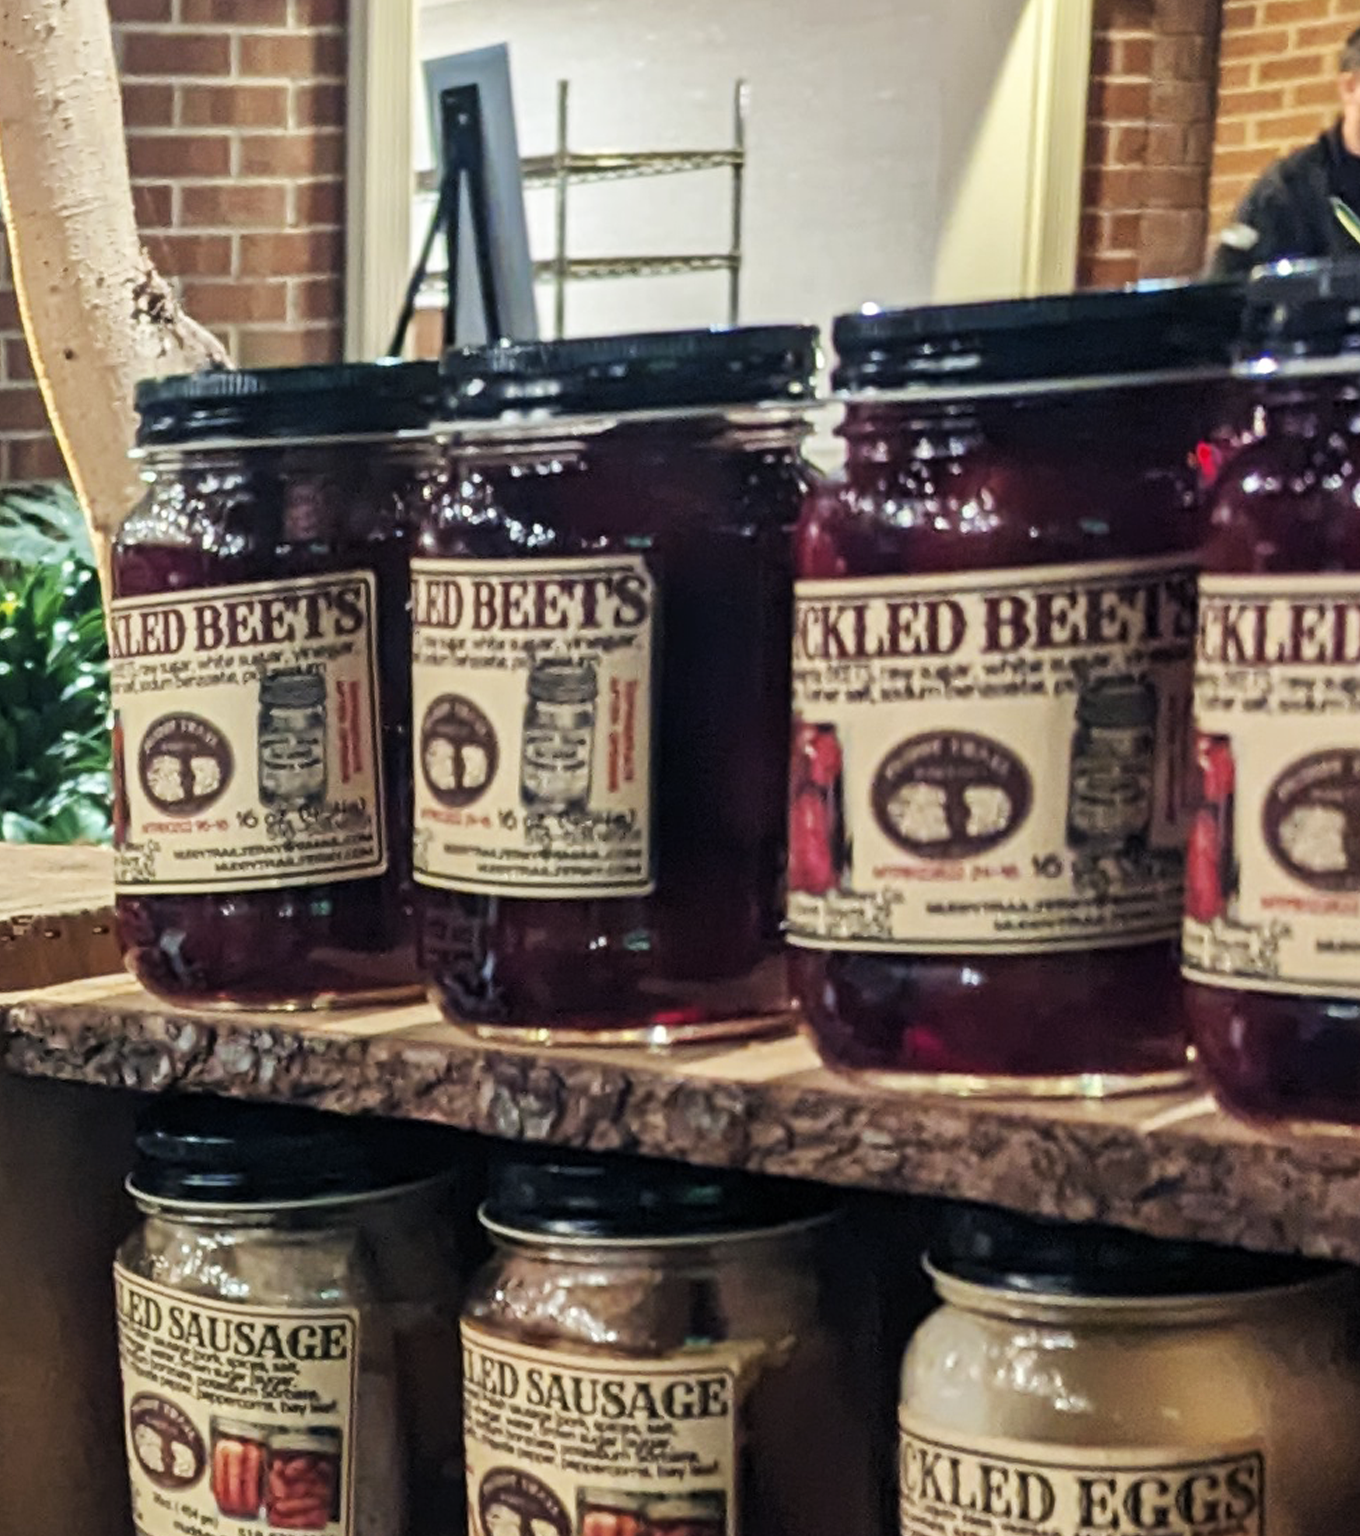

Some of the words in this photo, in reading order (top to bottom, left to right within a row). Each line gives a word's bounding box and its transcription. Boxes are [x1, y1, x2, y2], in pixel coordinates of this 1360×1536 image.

[111, 607, 187, 660] KLED
[192, 584, 365, 652] BEETS
[470, 574, 649, 632] BEETS
[1199, 603, 1360, 665] CKLED
[167, 1304, 348, 1361] SAUSAGE
[525, 1365, 730, 1421] SAUSAGE
[902, 1441, 1056, 1525] CKLED
[1075, 1461, 1259, 1532] EGGS
